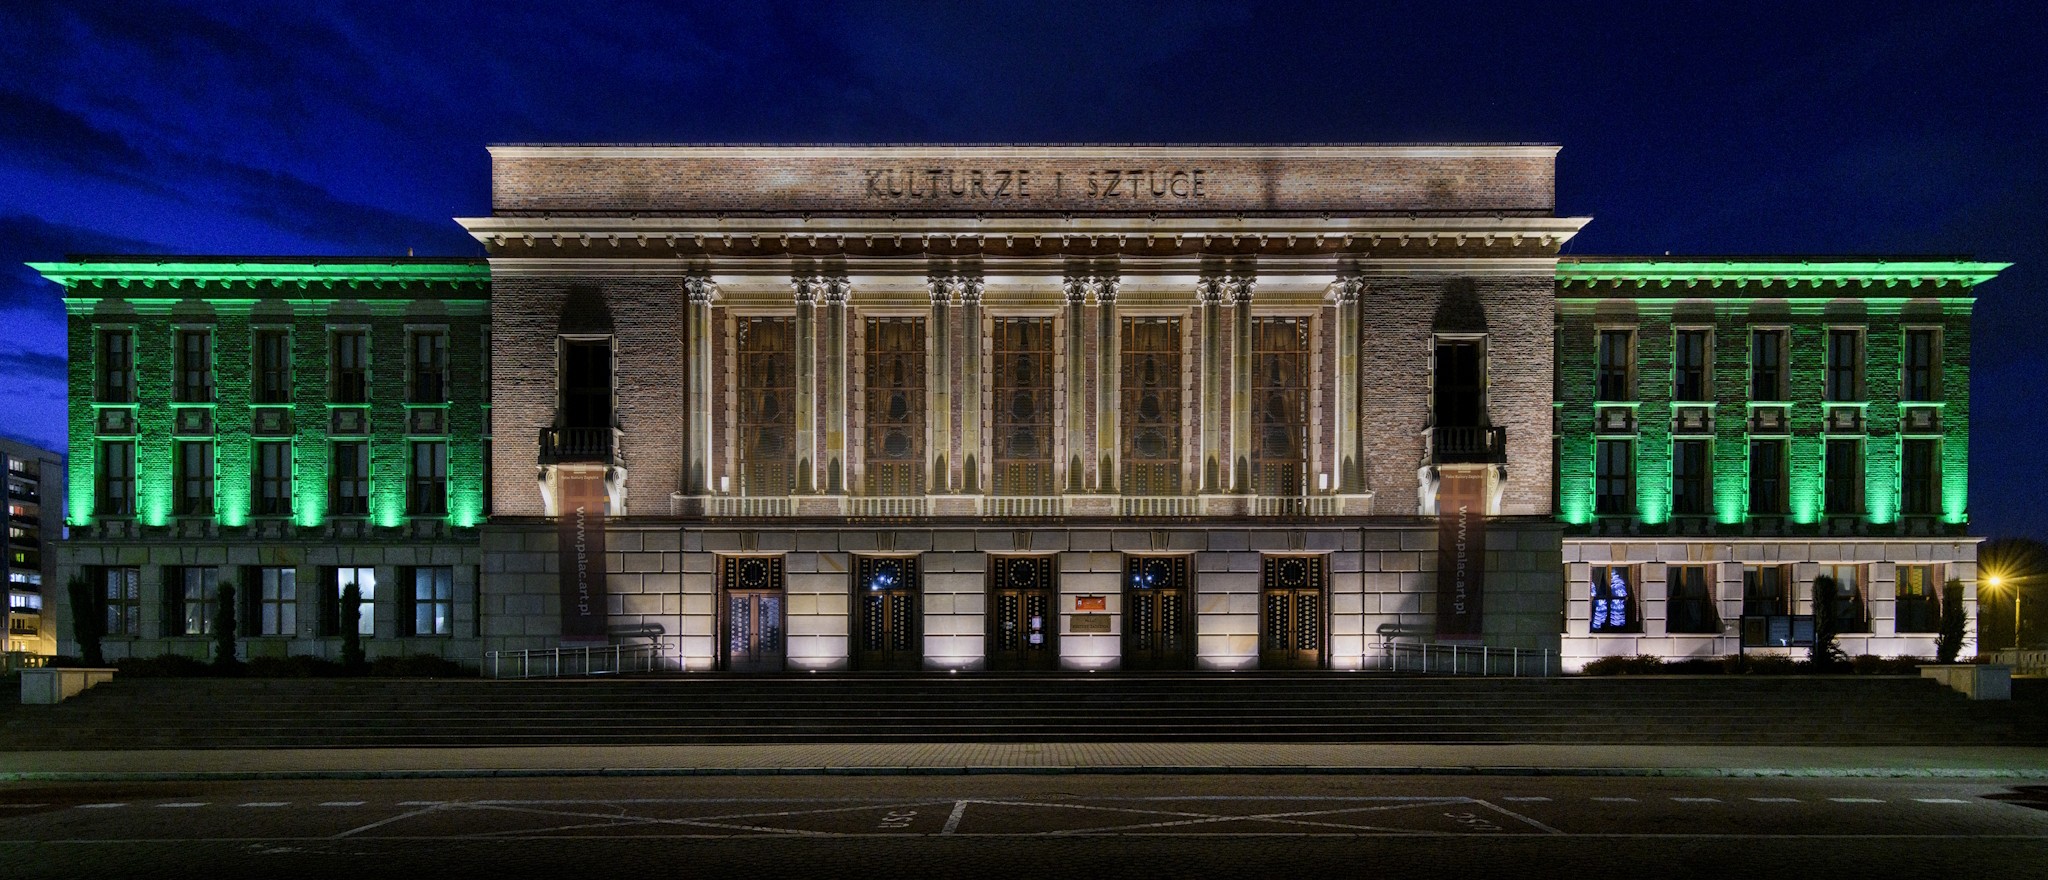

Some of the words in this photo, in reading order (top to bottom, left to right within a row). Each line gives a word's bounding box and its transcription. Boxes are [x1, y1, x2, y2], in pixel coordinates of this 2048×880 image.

[865, 168, 1031, 199] KULTURZE
[1054, 171, 1063, 199] I
[1087, 168, 1206, 199] SZTUCE
[575, 506, 591, 616] www.palac.art.pl
[1454, 505, 1468, 614] www.palac.art.pl
